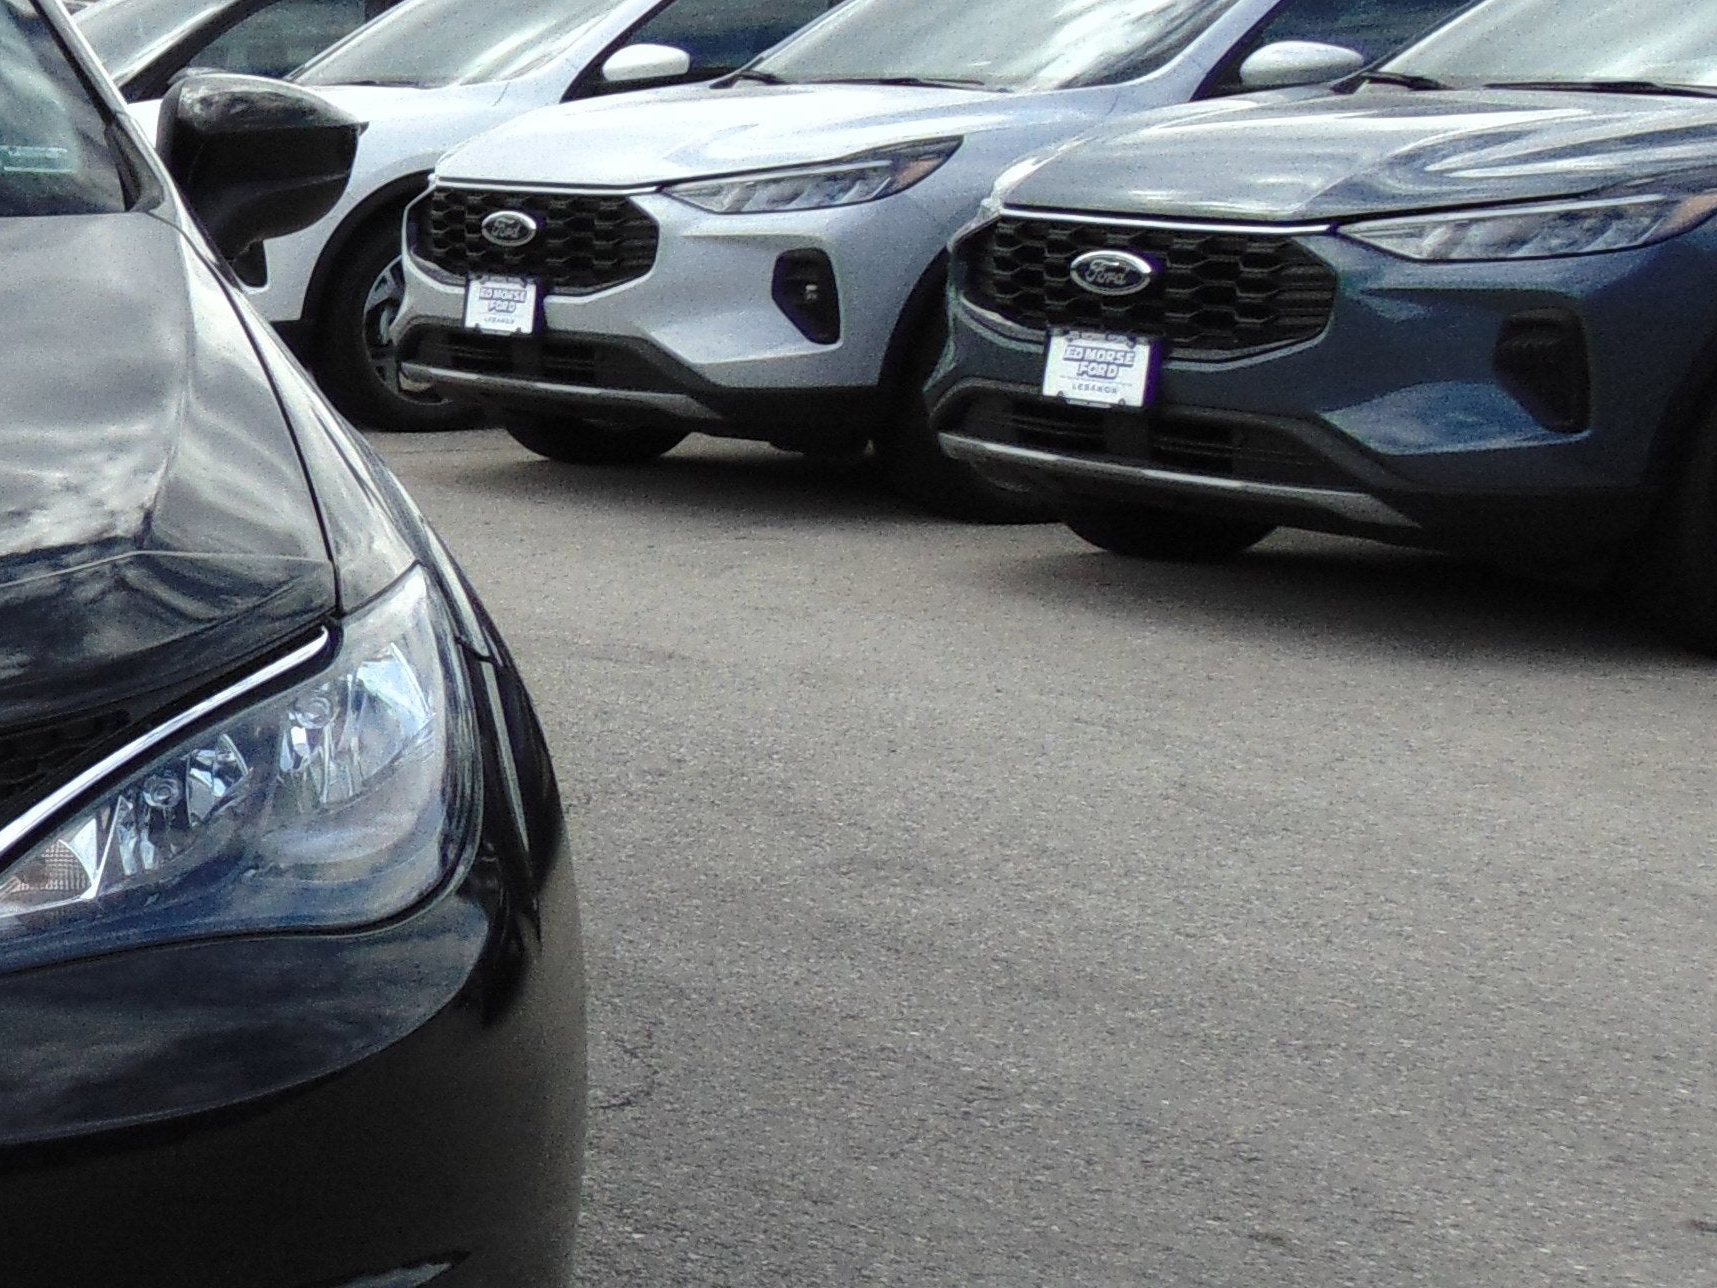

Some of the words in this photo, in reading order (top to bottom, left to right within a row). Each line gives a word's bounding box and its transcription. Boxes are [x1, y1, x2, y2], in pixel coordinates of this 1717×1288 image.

[1085, 259, 1128, 285] Ford
[1064, 345, 1083, 361] ED
[1084, 347, 1136, 367] MORSE
[1077, 363, 1119, 379] FORD
